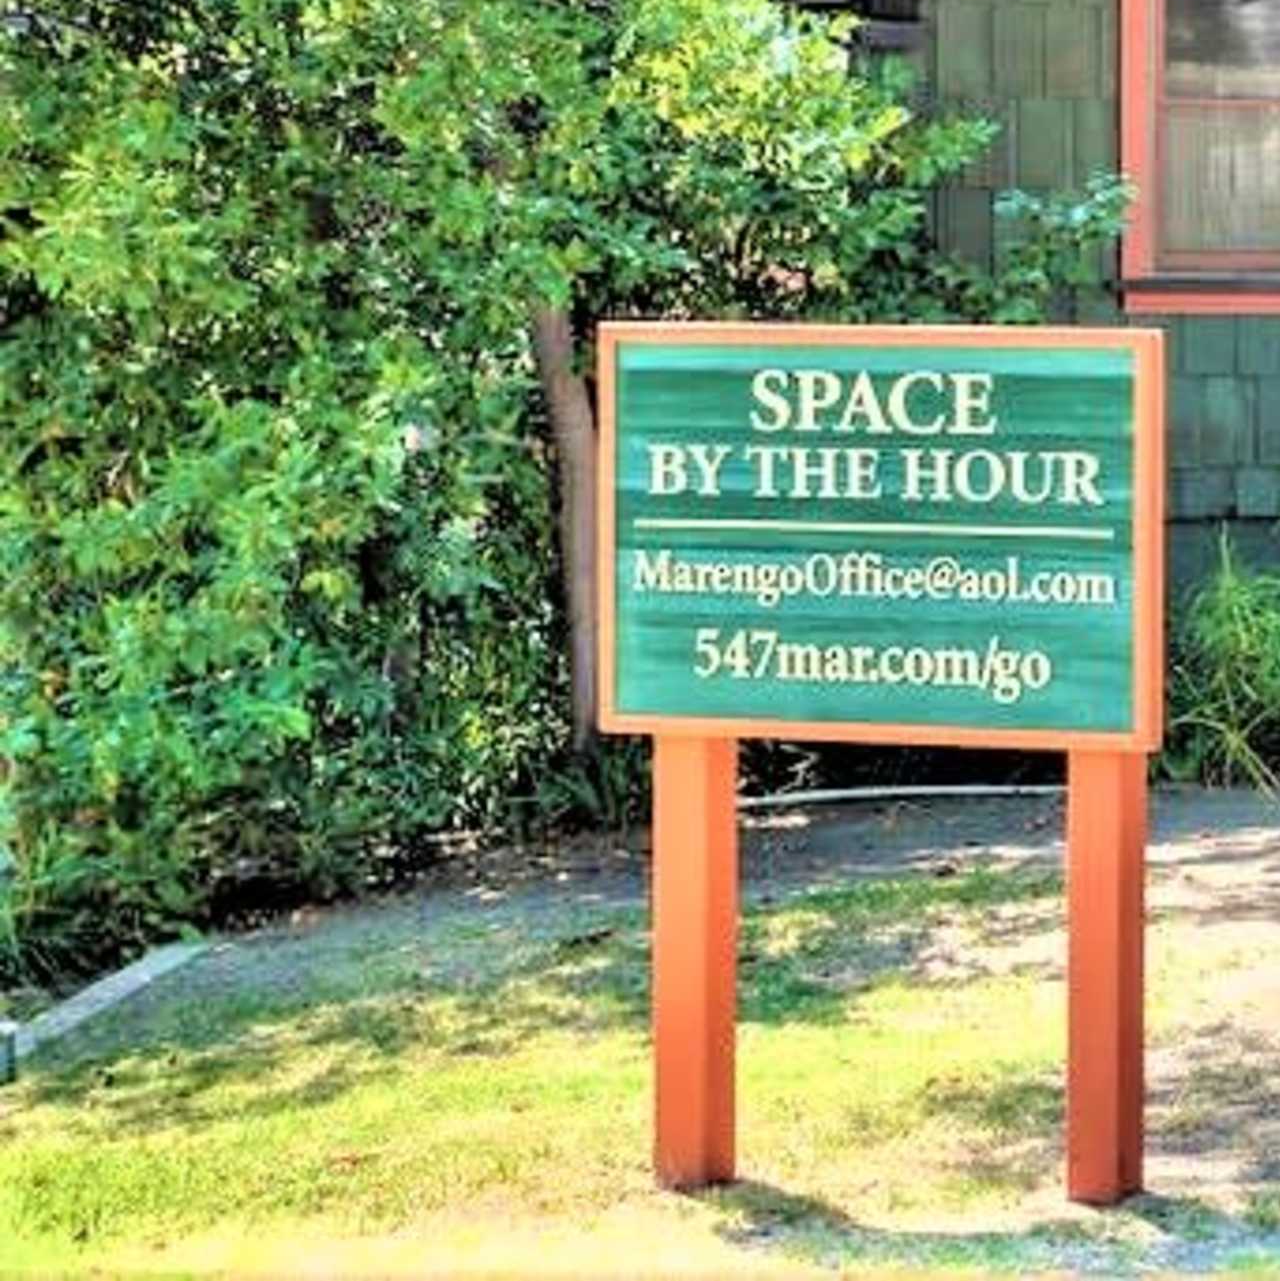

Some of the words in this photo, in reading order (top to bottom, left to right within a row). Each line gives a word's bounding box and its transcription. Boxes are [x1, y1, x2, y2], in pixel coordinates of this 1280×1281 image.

[749, 368, 998, 436] SPACE
[647, 443, 733, 497] BY
[744, 444, 883, 500] THE
[900, 448, 1104, 507] HOUR
[632, 548, 1116, 608] MarengoOffice@aol.com
[693, 627, 1052, 704] 547mar.com/go
